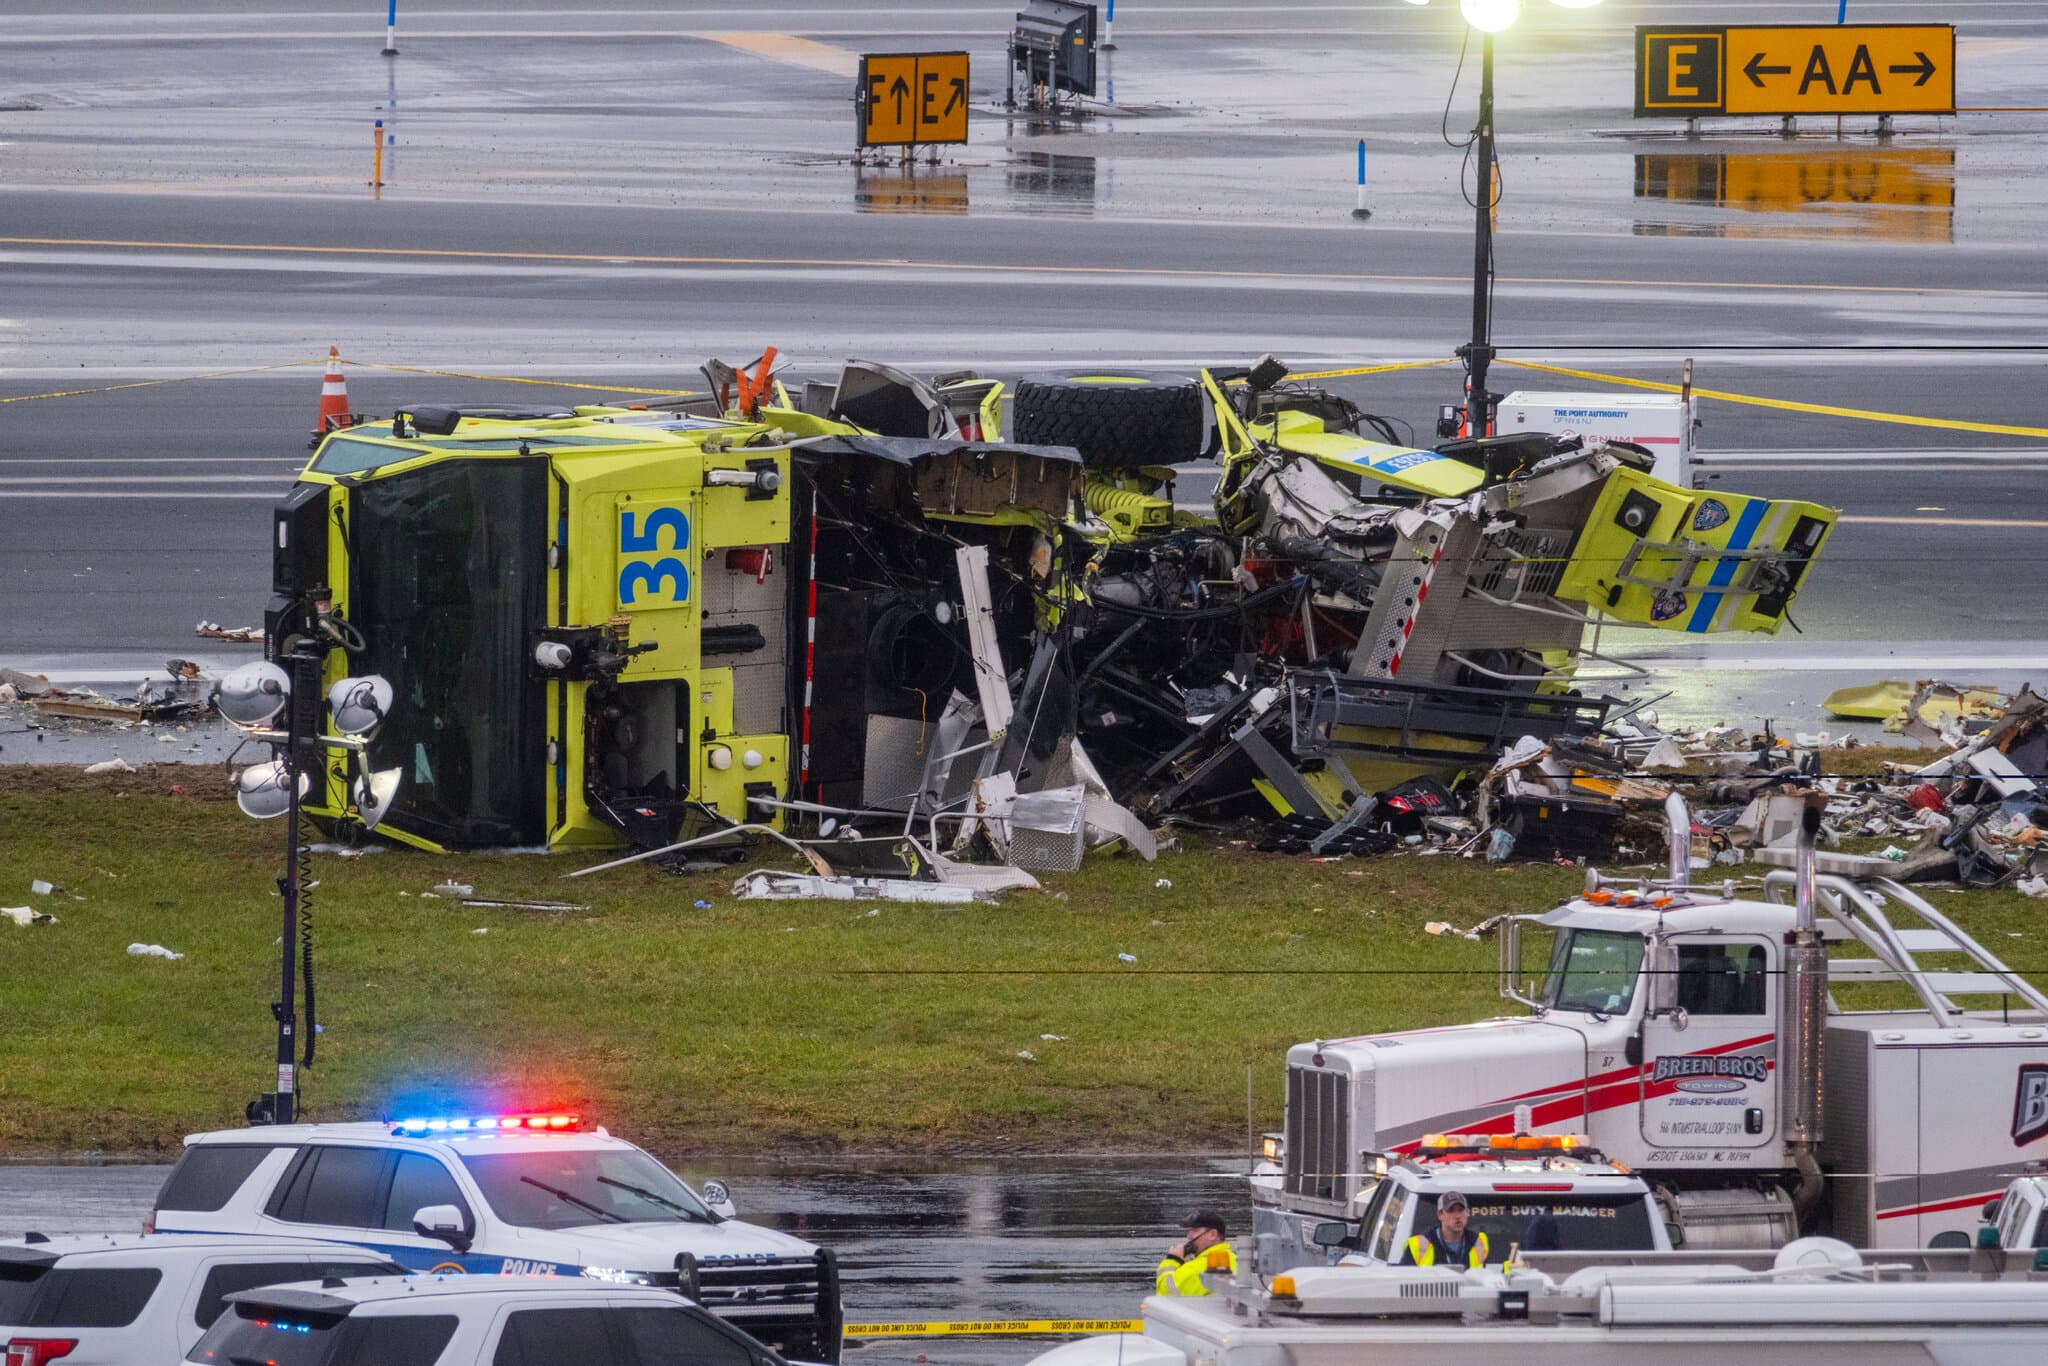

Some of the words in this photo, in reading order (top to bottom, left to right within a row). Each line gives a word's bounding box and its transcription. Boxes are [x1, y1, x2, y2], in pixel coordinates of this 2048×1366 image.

[1667, 44, 1699, 97] E
[1798, 44, 1882, 95] AA
[868, 74, 886, 126] F
[921, 72, 939, 124] E
[1553, 409, 1567, 417] THE
[1588, 410, 1628, 418] AUTHORITY
[619, 506, 690, 605] 35
[1653, 1056, 1714, 1083] BREEN
[1716, 1056, 1768, 1082] BROS
[1684, 1081, 1738, 1090] TOWING
[1647, 1151, 1679, 1162] USDOT
[1469, 1206, 1505, 1216] PORT
[1511, 1206, 1546, 1216] DUTY
[1552, 1206, 1617, 1218] MANAGER
[501, 1258, 557, 1277] POLICE
